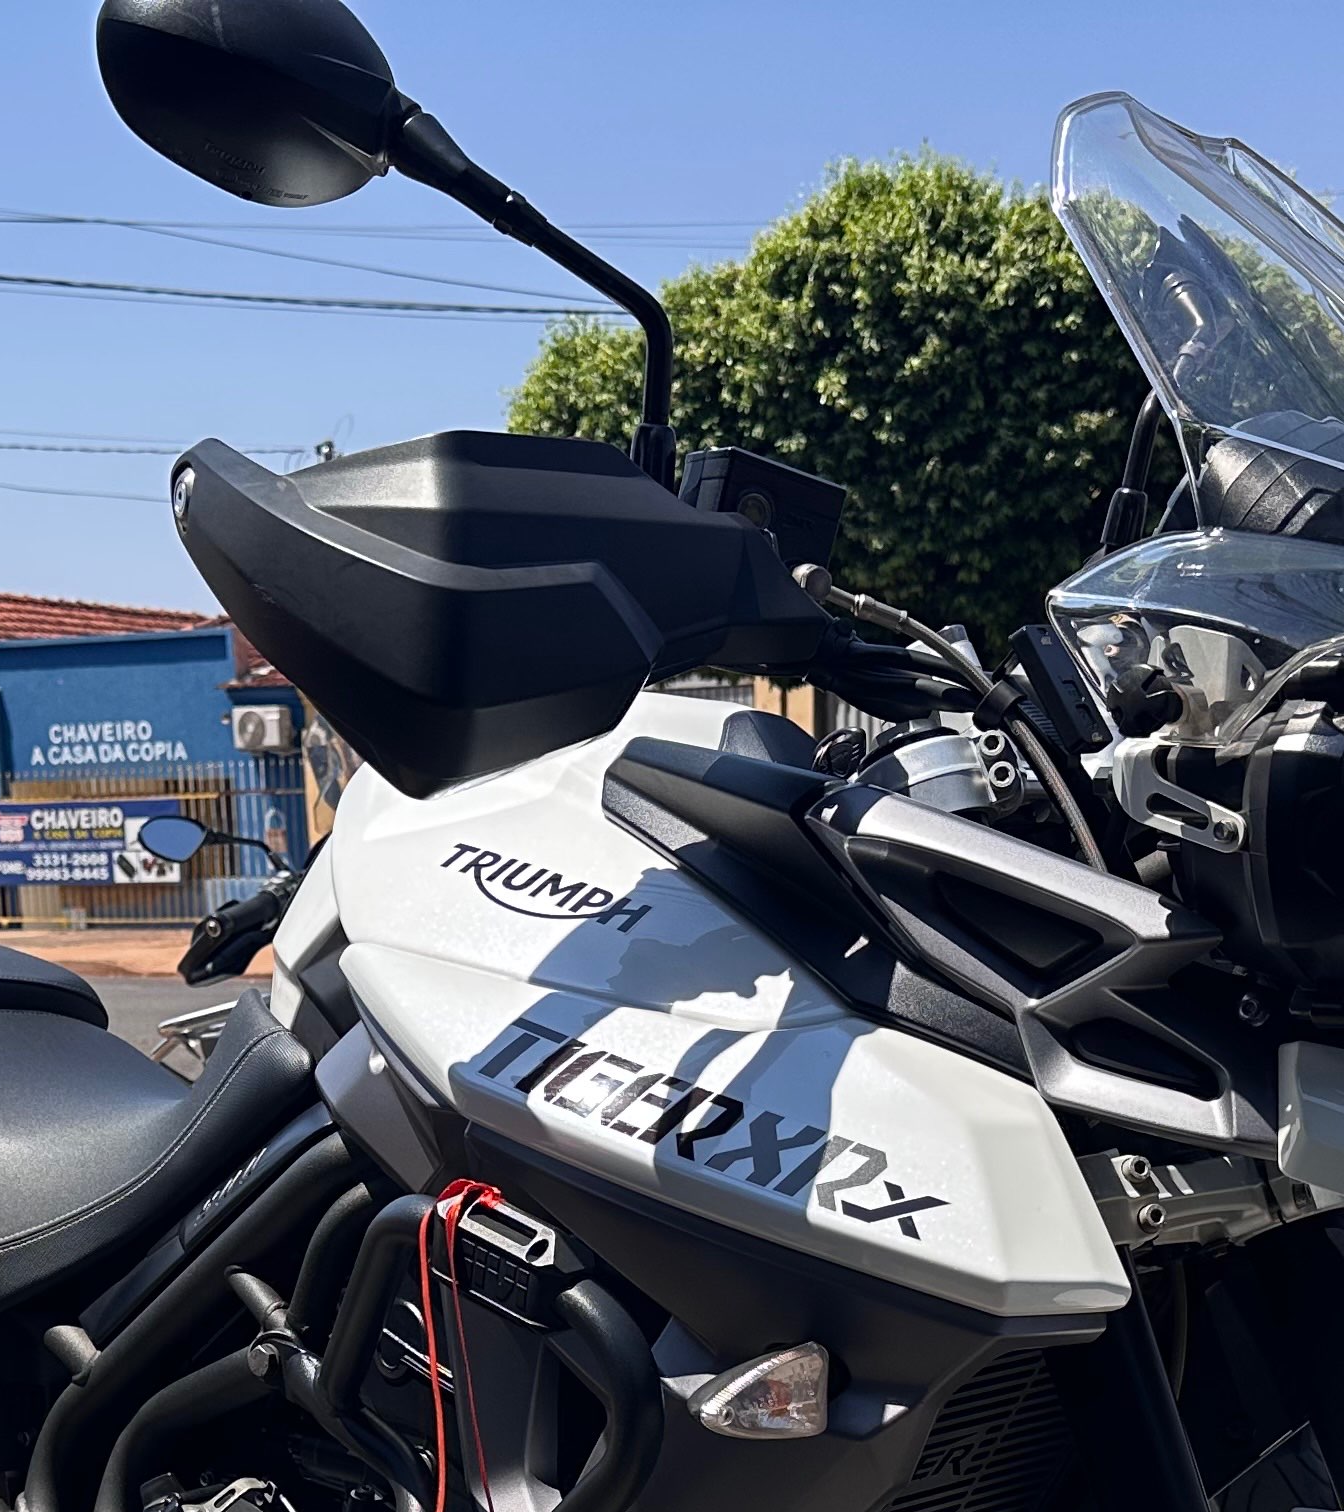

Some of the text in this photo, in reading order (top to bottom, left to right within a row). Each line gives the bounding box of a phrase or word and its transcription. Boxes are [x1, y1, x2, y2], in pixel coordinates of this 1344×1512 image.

[48, 719, 153, 744] CHAVEIRO
[31, 740, 188, 766] A CASA DA COPIA
[30, 807, 124, 830] CHAVEIRO
[440, 843, 653, 934] TRIUMPH
